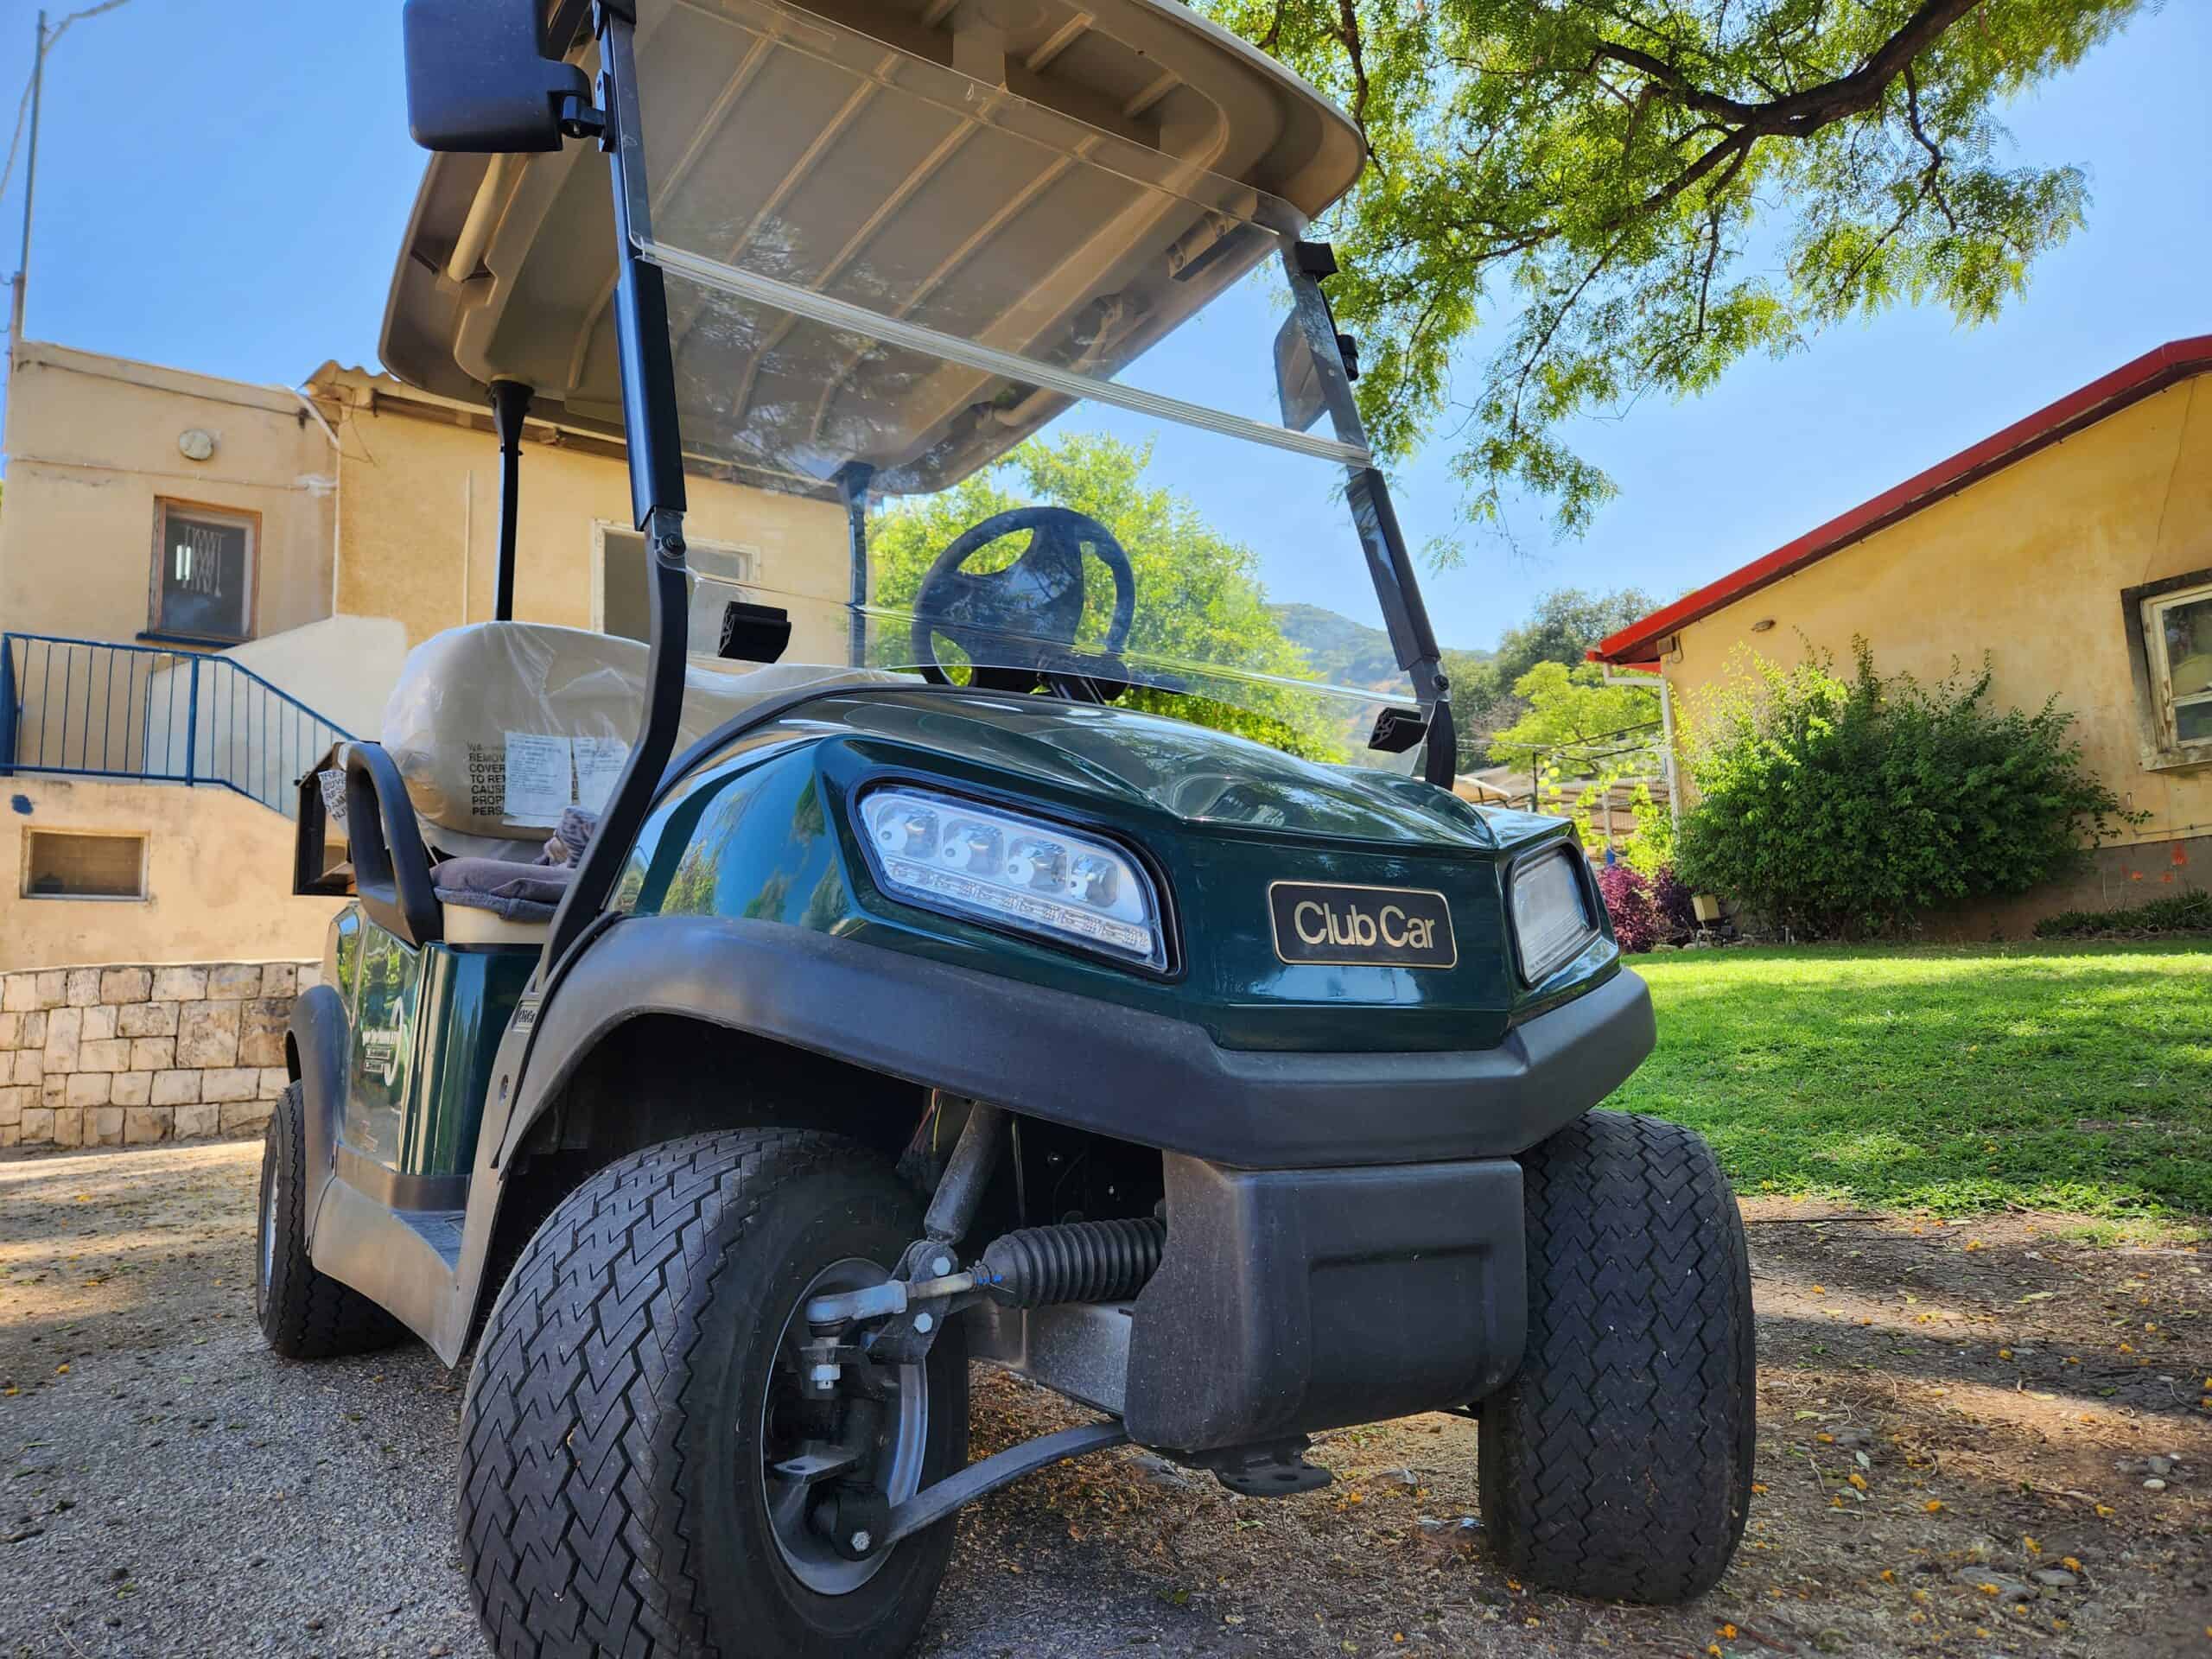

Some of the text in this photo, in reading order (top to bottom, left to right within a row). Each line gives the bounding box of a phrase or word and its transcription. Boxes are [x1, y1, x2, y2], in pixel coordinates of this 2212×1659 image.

[470, 774, 485, 784] TO
[472, 795, 505, 805] PROP
[1294, 901, 1435, 949] Club Car
